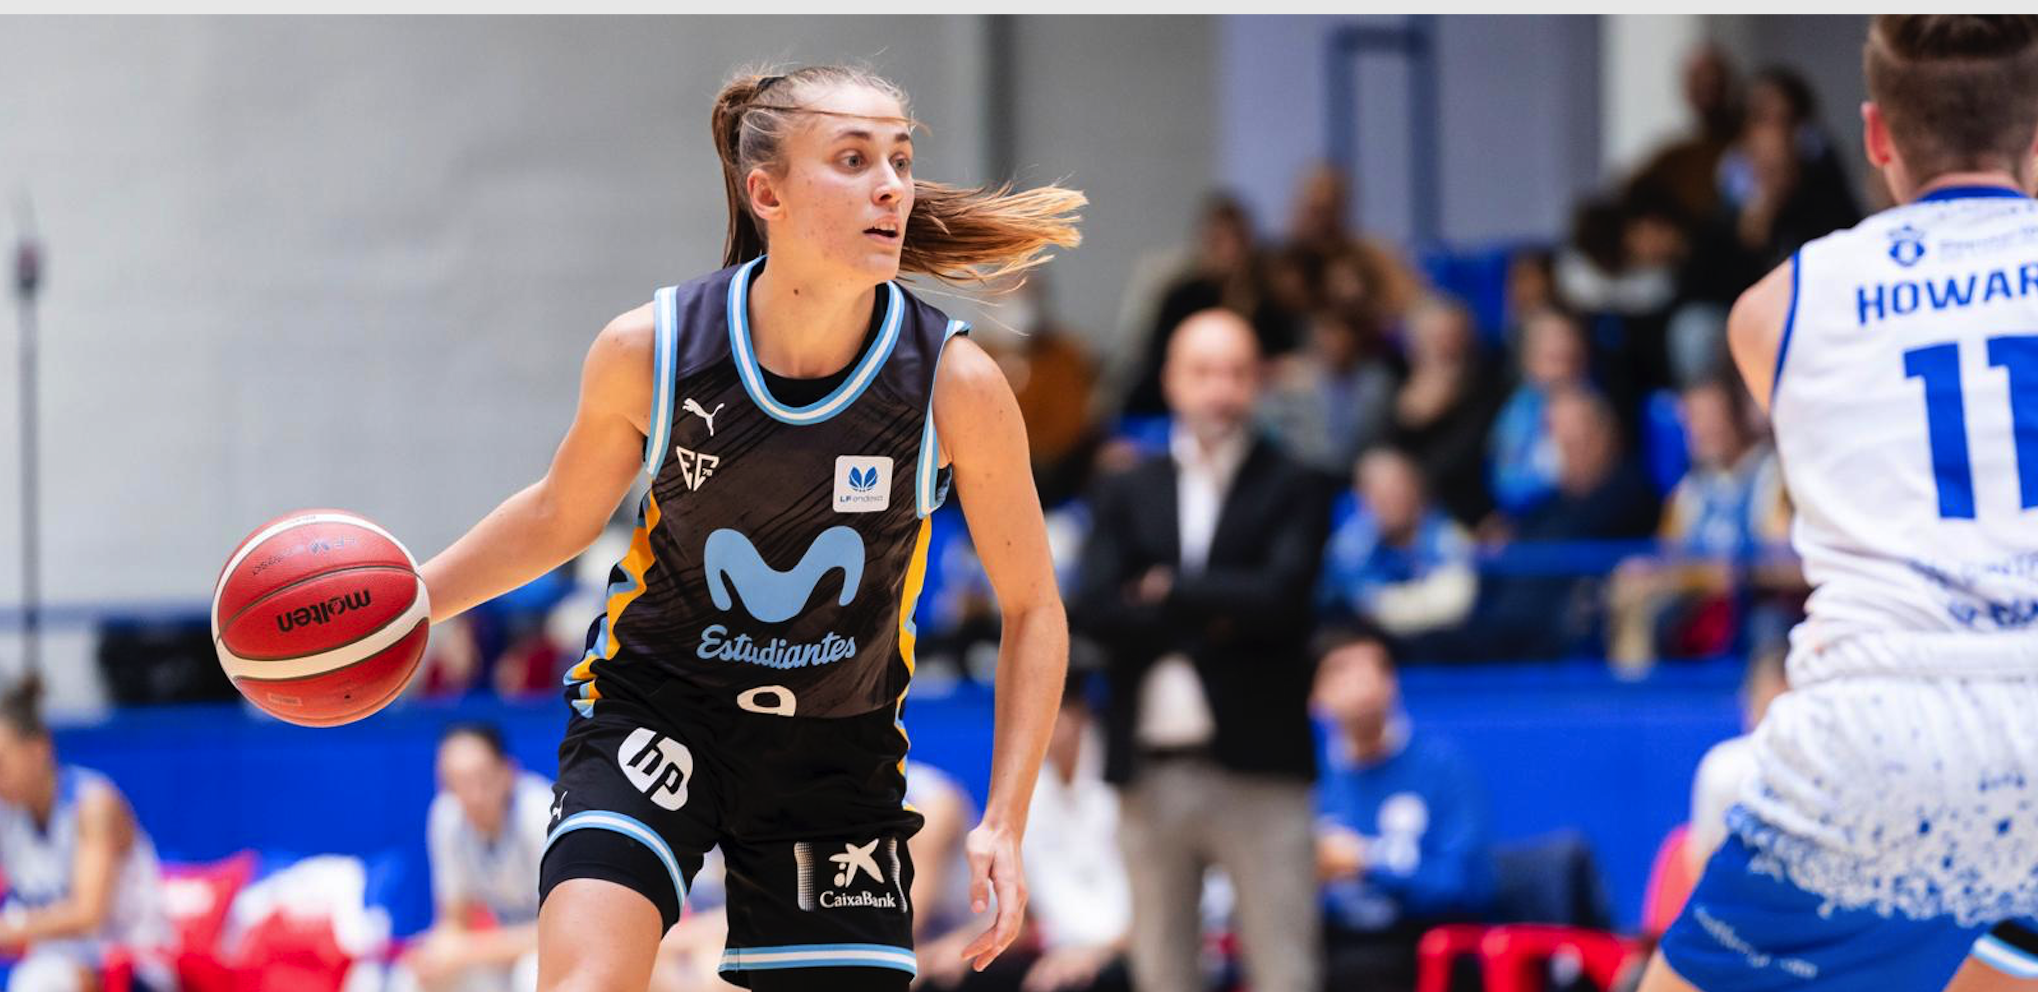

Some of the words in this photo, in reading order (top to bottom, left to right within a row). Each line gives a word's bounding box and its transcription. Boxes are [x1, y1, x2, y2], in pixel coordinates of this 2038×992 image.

[276, 589, 372, 633] molten
[696, 624, 857, 670] Estudiantes
[626, 731, 685, 799] hp
[819, 890, 896, 908] CaixaBank
